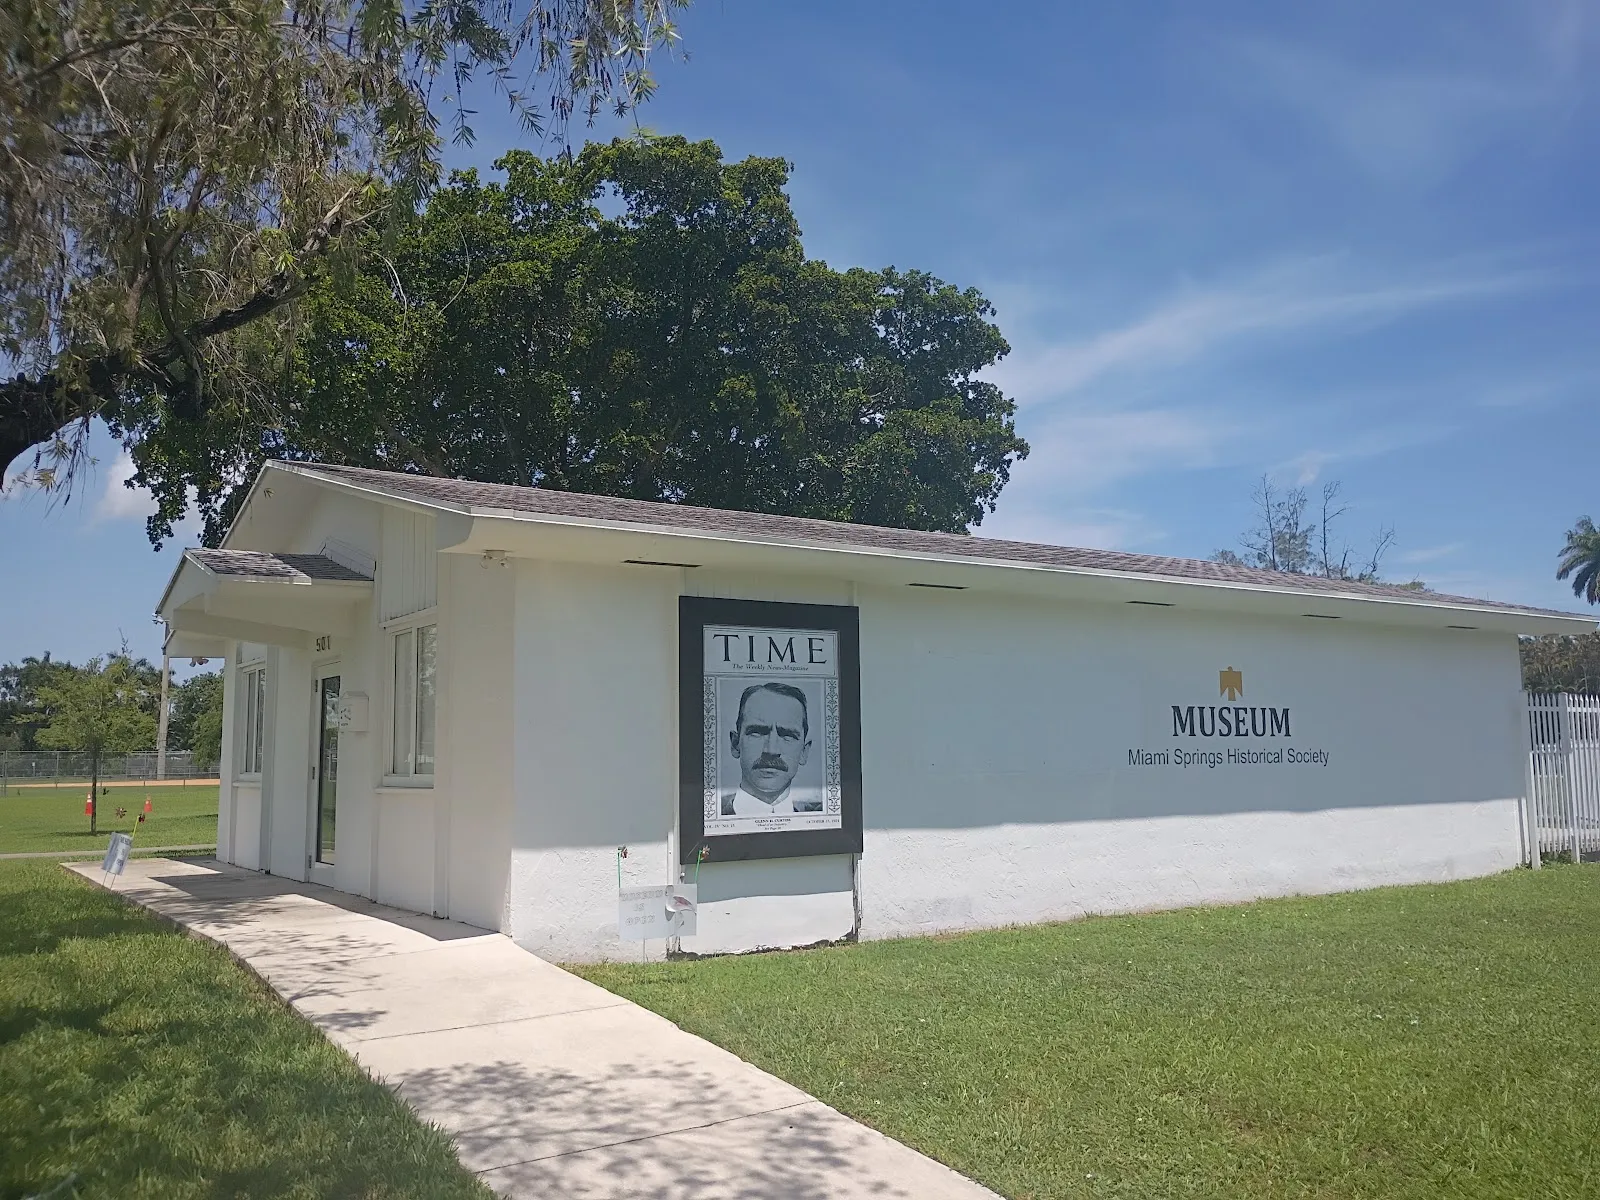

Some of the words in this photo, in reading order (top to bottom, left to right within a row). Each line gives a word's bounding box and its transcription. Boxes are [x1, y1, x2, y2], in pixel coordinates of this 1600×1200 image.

[316, 635, 331, 652] 501
[712, 634, 828, 665] TIME
[746, 663, 765, 671] Weekly
[1171, 705, 1292, 737] MUSEUM
[1128, 748, 1169, 766] Miami
[1173, 748, 1223, 769] Springs
[1227, 748, 1283, 764] Historical
[1287, 748, 1330, 767] Society
